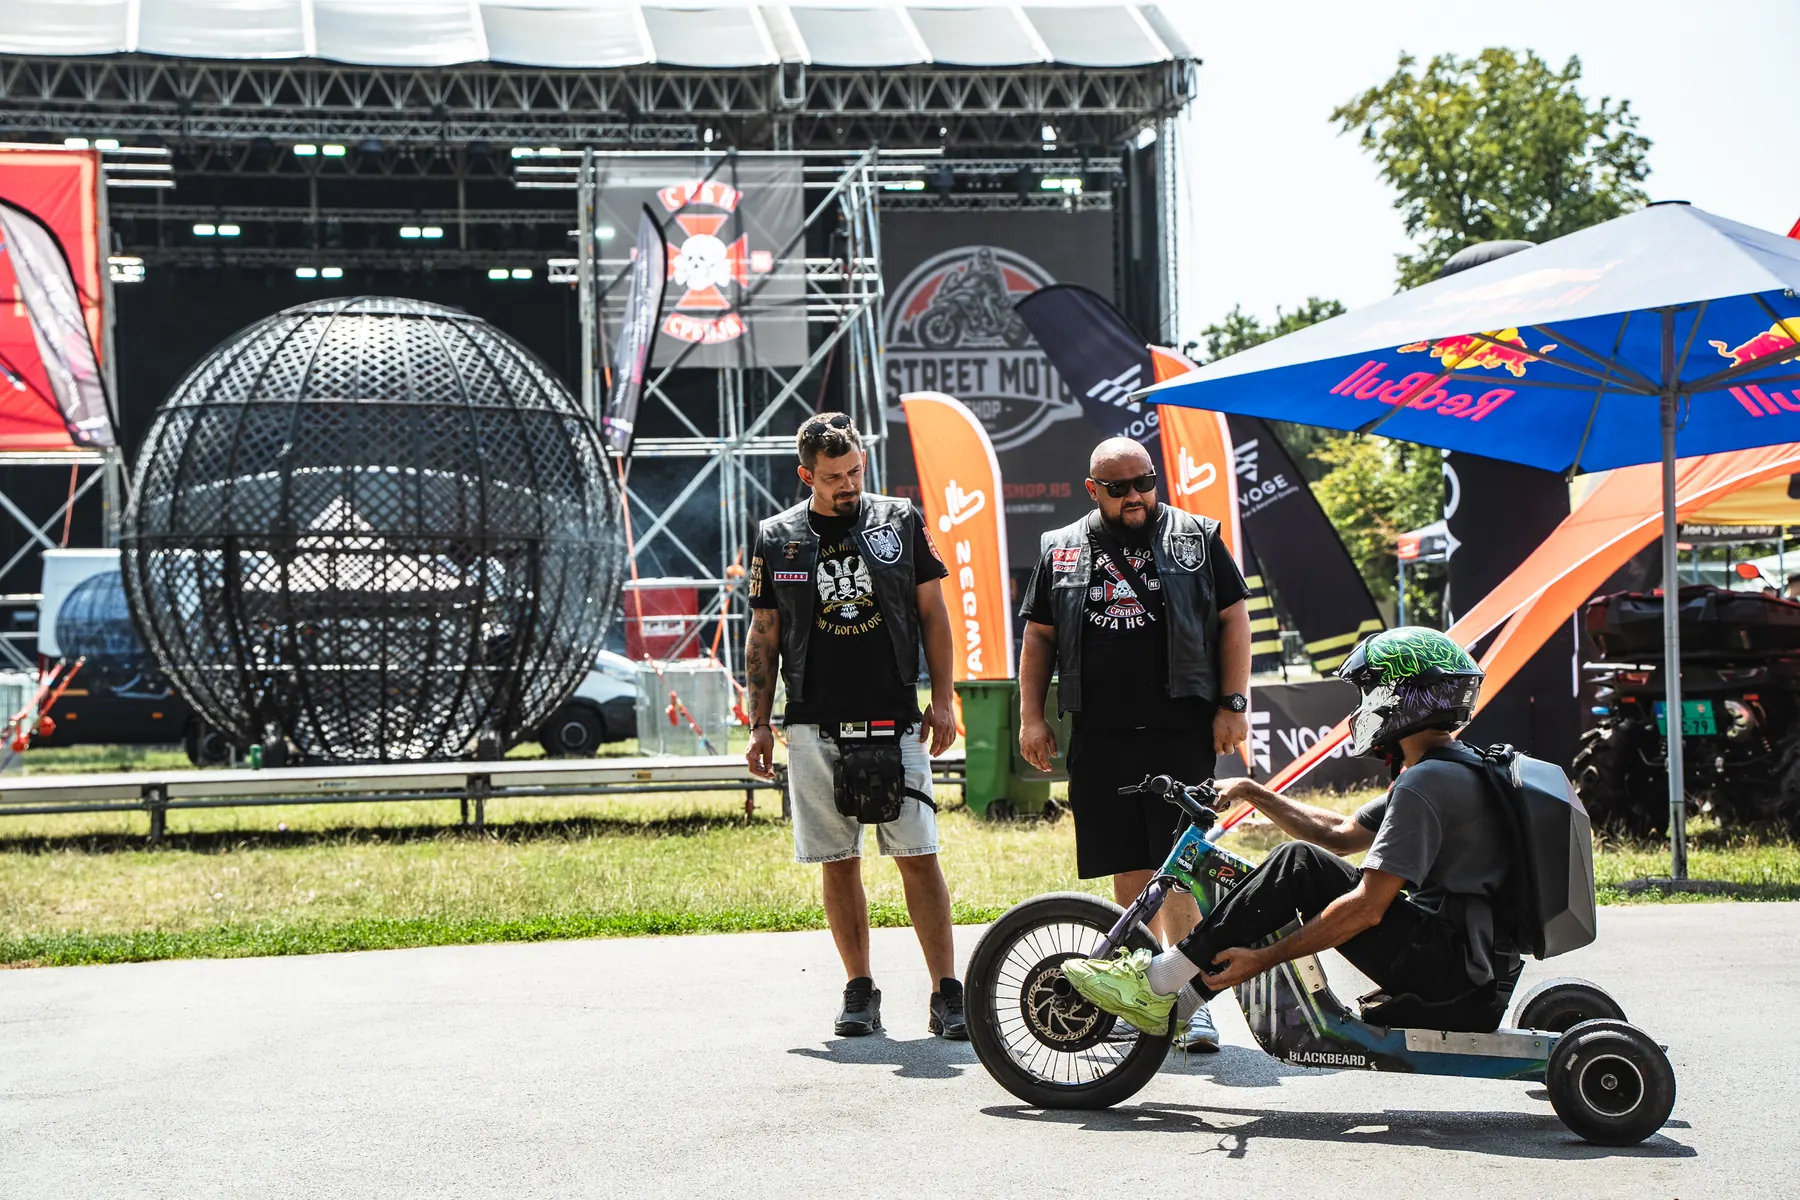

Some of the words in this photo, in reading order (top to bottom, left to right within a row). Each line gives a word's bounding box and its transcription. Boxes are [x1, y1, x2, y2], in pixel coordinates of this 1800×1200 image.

[886, 358, 987, 398] STREET
[1117, 410, 1158, 438] VOG
[1238, 474, 1289, 508] VOGE
[834, 625, 859, 635] БОГА
[1289, 1051, 1366, 1066] BLACKBEARD
